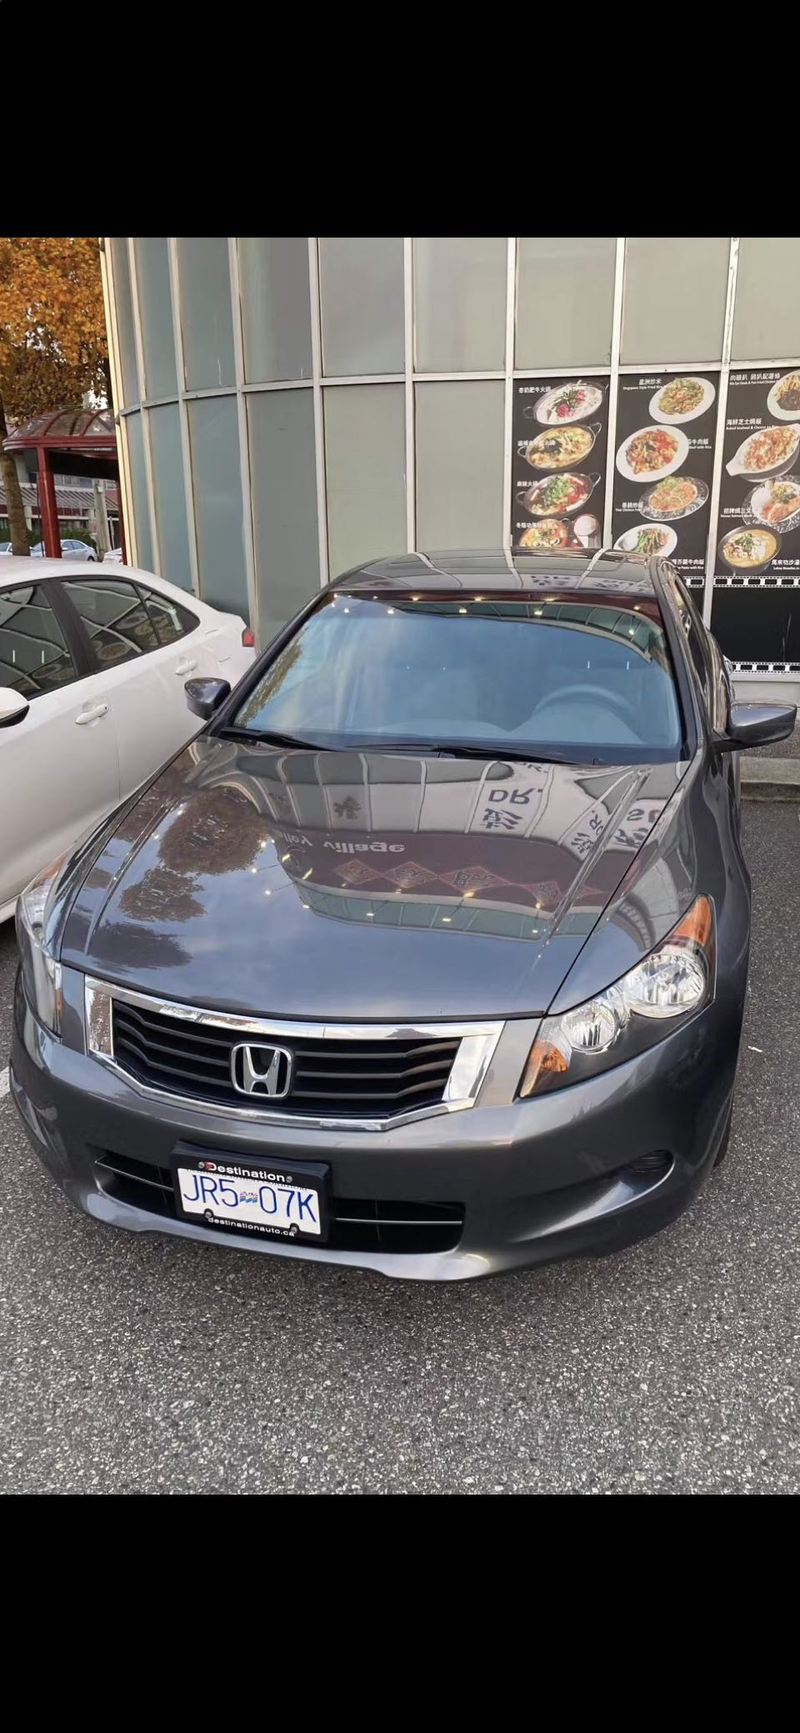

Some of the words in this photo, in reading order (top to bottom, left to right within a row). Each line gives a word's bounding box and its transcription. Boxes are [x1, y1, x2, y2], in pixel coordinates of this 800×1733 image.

[204, 1162, 286, 1183] Destination
[183, 1174, 239, 1207] JR5
[208, 1217, 295, 1237] destinationauto.ca
